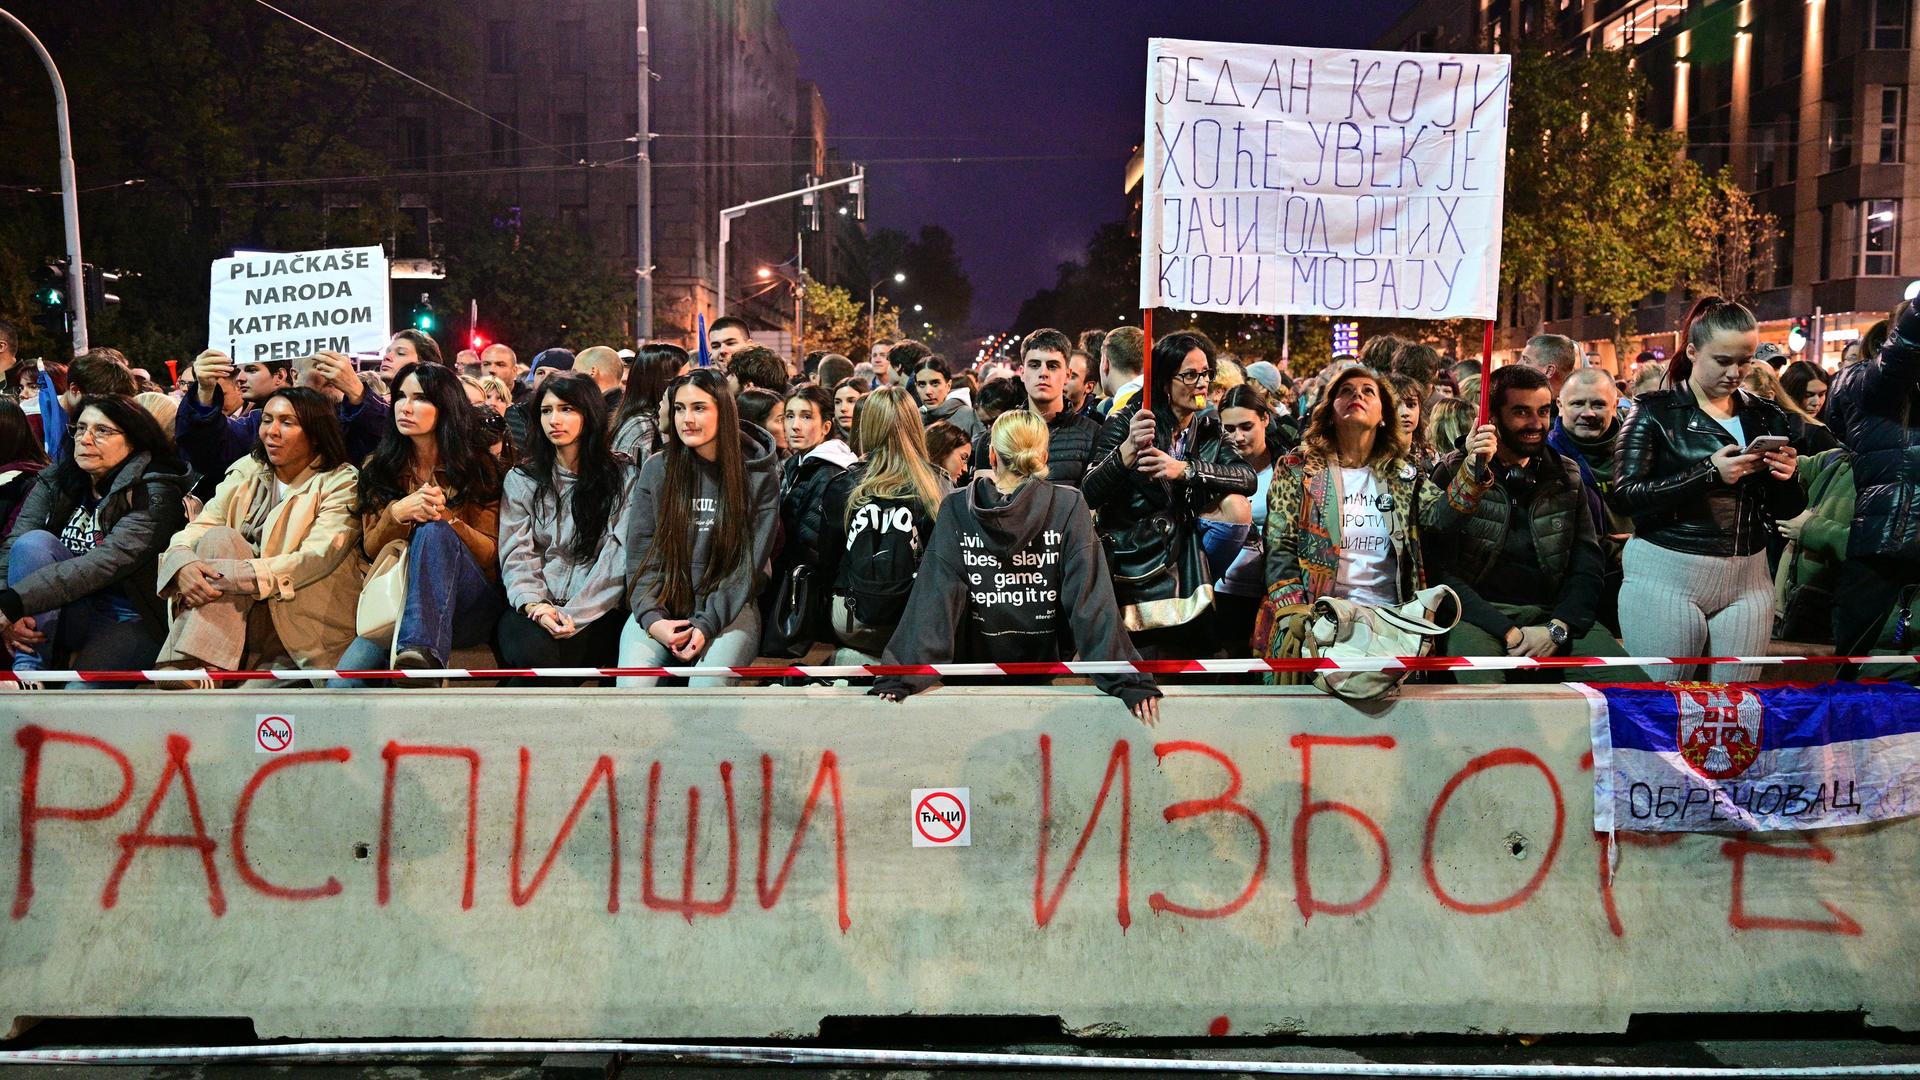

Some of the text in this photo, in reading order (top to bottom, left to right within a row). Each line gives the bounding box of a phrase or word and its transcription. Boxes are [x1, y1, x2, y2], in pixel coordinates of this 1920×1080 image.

[1155, 55, 1511, 129] ЈЕДАН КОЈИ
[1303, 120, 1428, 189] УВЕК
[1436, 129, 1480, 191] ЈЕ
[1158, 194, 1466, 257] ЈАЧИ ОД ОНИХ
[230, 250, 369, 280] PLJAČKAŠE
[245, 281, 352, 306] NARODA
[1158, 253, 1463, 312] КОЈИ МОРАЈУ
[228, 306, 372, 336] KATRANOM
[254, 336, 350, 361] PERJEM
[692, 498, 717, 511] KUL
[1043, 529, 1063, 546] th
[963, 549, 1059, 569] ibes, slayin
[994, 571, 1048, 588] game,
[971, 587, 1057, 607] eping it re
[10, 723, 852, 934] РАСПИШИ
[921, 810, 960, 824] ЋАЦИ
